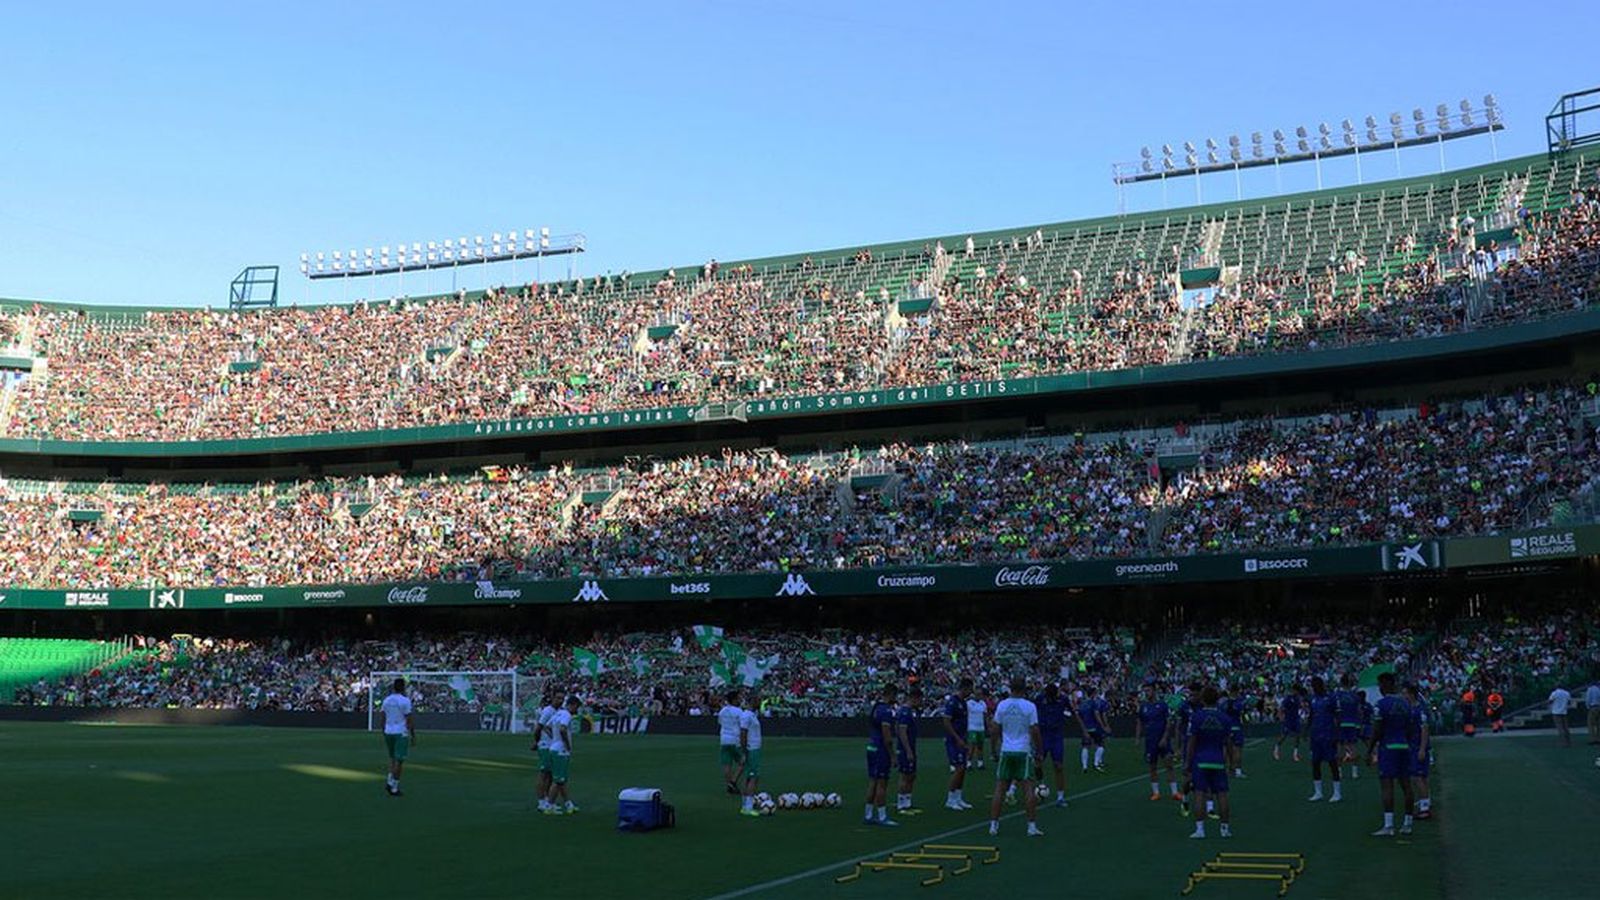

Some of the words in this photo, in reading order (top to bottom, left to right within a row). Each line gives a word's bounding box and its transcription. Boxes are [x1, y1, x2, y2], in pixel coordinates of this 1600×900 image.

[567, 416, 610, 427] como
[623, 410, 673, 423] balas
[897, 388, 929, 401] del
[1529, 532, 1575, 547] REALE
[671, 583, 710, 593] bet365
[877, 575, 936, 588] Cruzcampo
